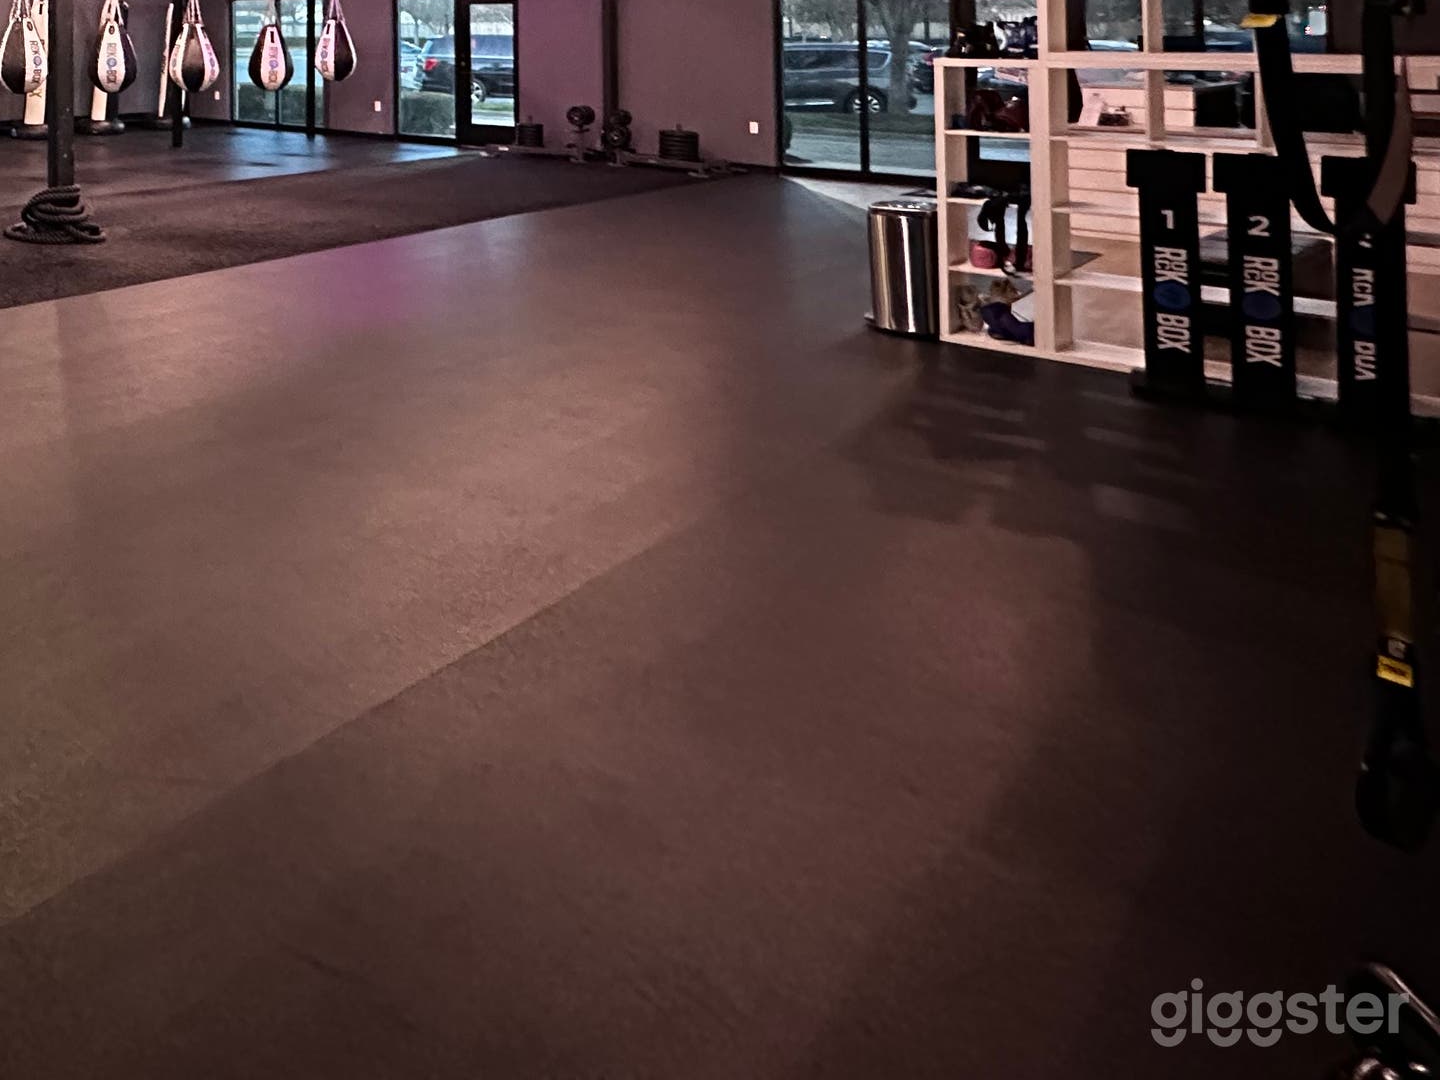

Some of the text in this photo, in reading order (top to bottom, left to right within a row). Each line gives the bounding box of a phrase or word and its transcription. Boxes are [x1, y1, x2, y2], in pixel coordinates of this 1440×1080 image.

[1161, 210, 1175, 229] 1
[1247, 216, 1270, 237] 2
[1157, 312, 1191, 354] BOX
[1244, 325, 1282, 367] BOX
